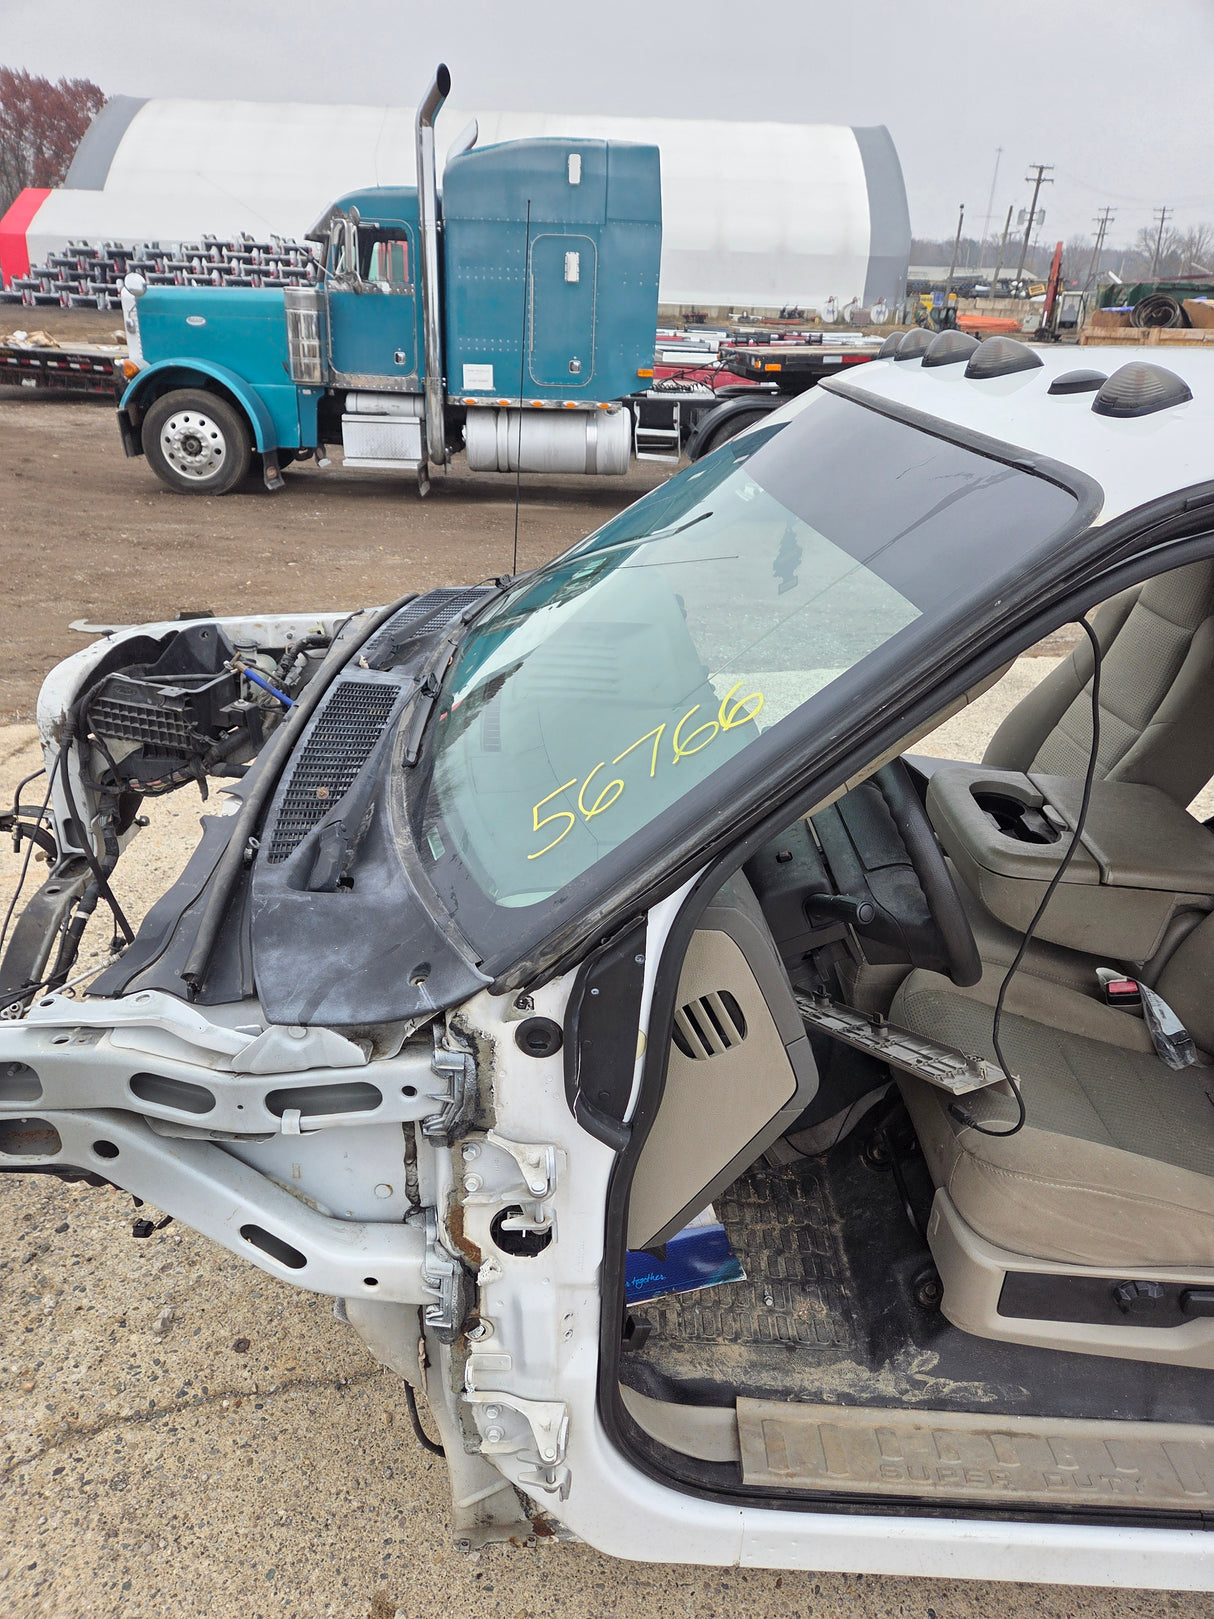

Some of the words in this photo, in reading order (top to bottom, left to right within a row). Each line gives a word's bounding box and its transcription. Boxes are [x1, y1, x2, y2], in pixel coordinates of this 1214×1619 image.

[527, 682, 764, 859] 56766
[880, 1464, 1017, 1490] SUPER
[1042, 1472, 1144, 1493] DUTY
